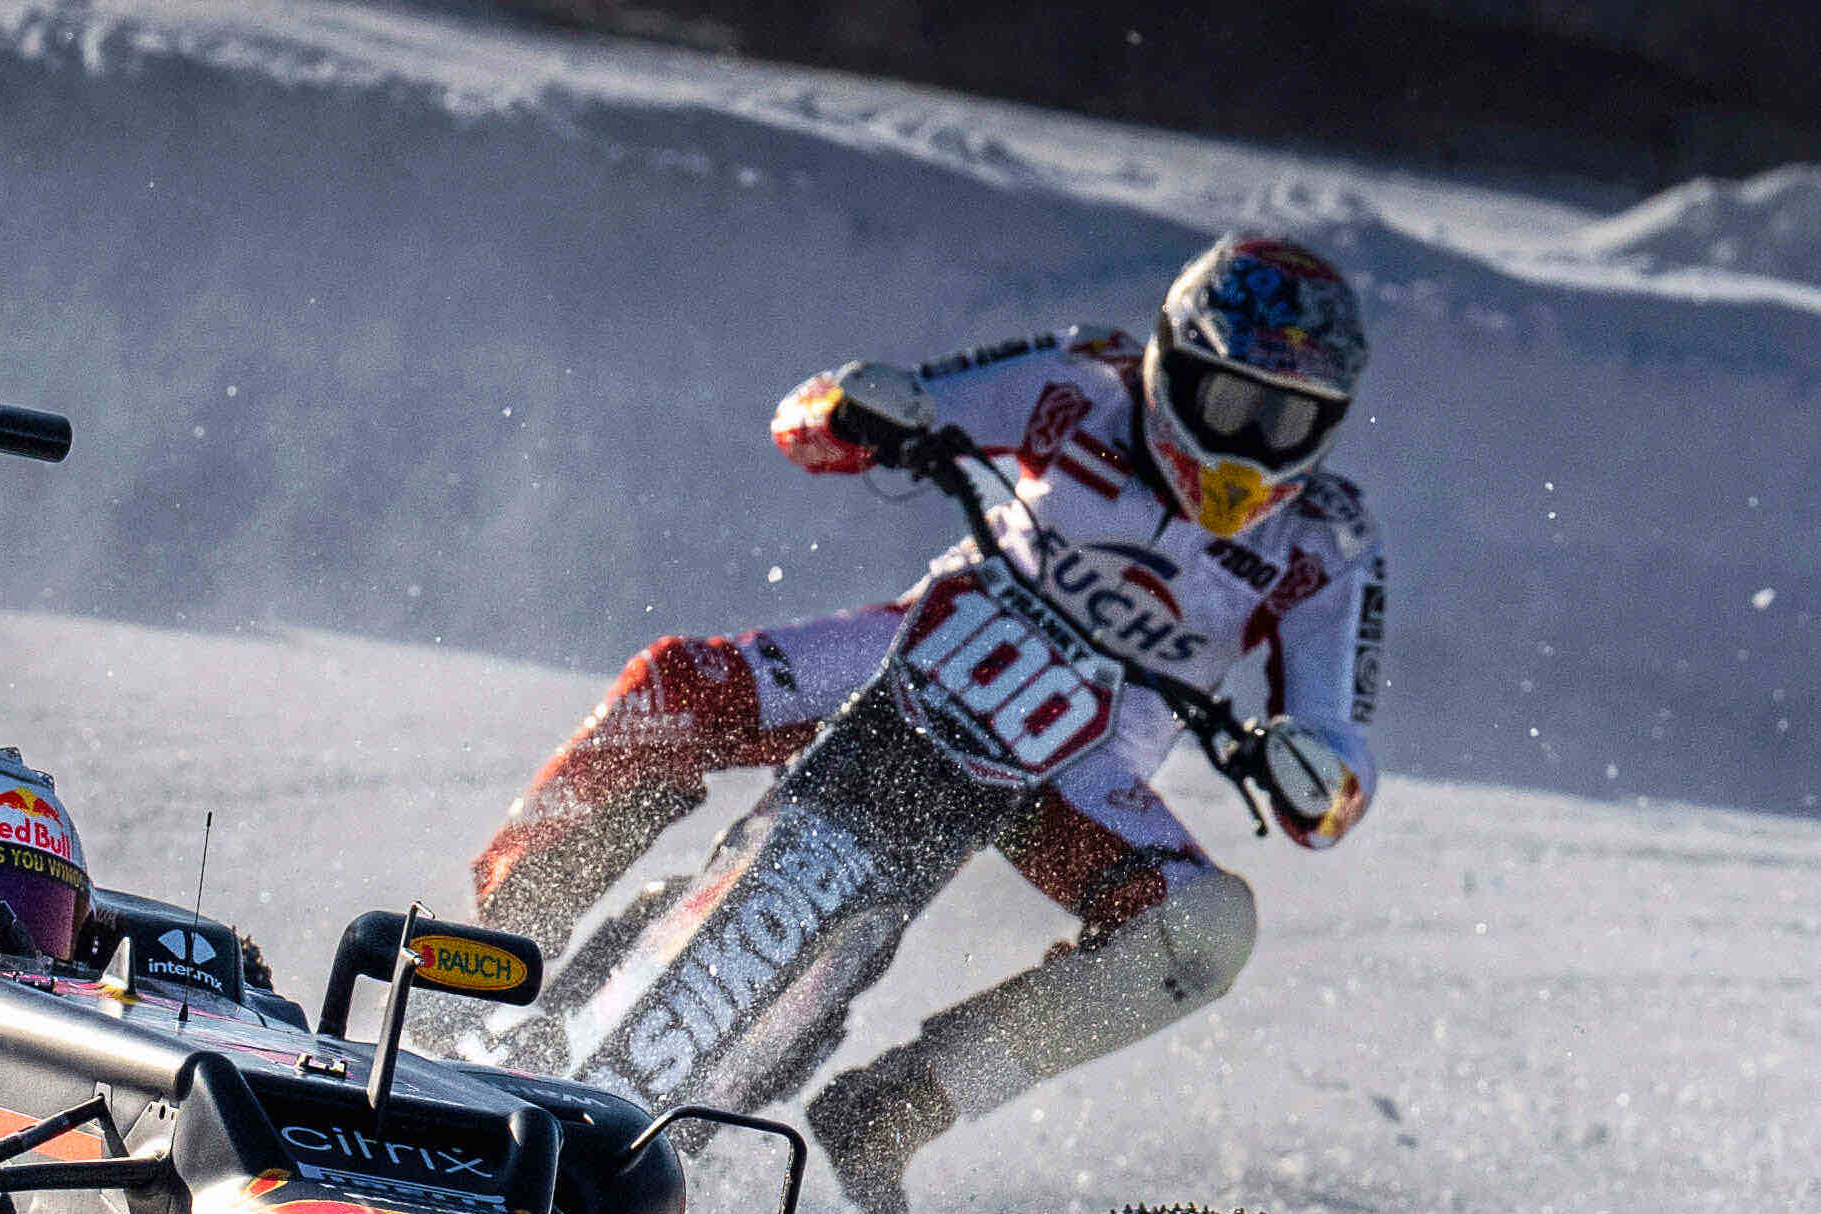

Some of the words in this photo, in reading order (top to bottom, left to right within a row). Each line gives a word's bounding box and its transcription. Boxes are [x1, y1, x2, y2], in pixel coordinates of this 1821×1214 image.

[905, 592, 1098, 767] 100
[34, 821, 71, 861] Bull
[10, 849, 44, 872] YOU
[147, 957, 225, 993] inter.mx
[436, 949, 513, 982] RAUCH
